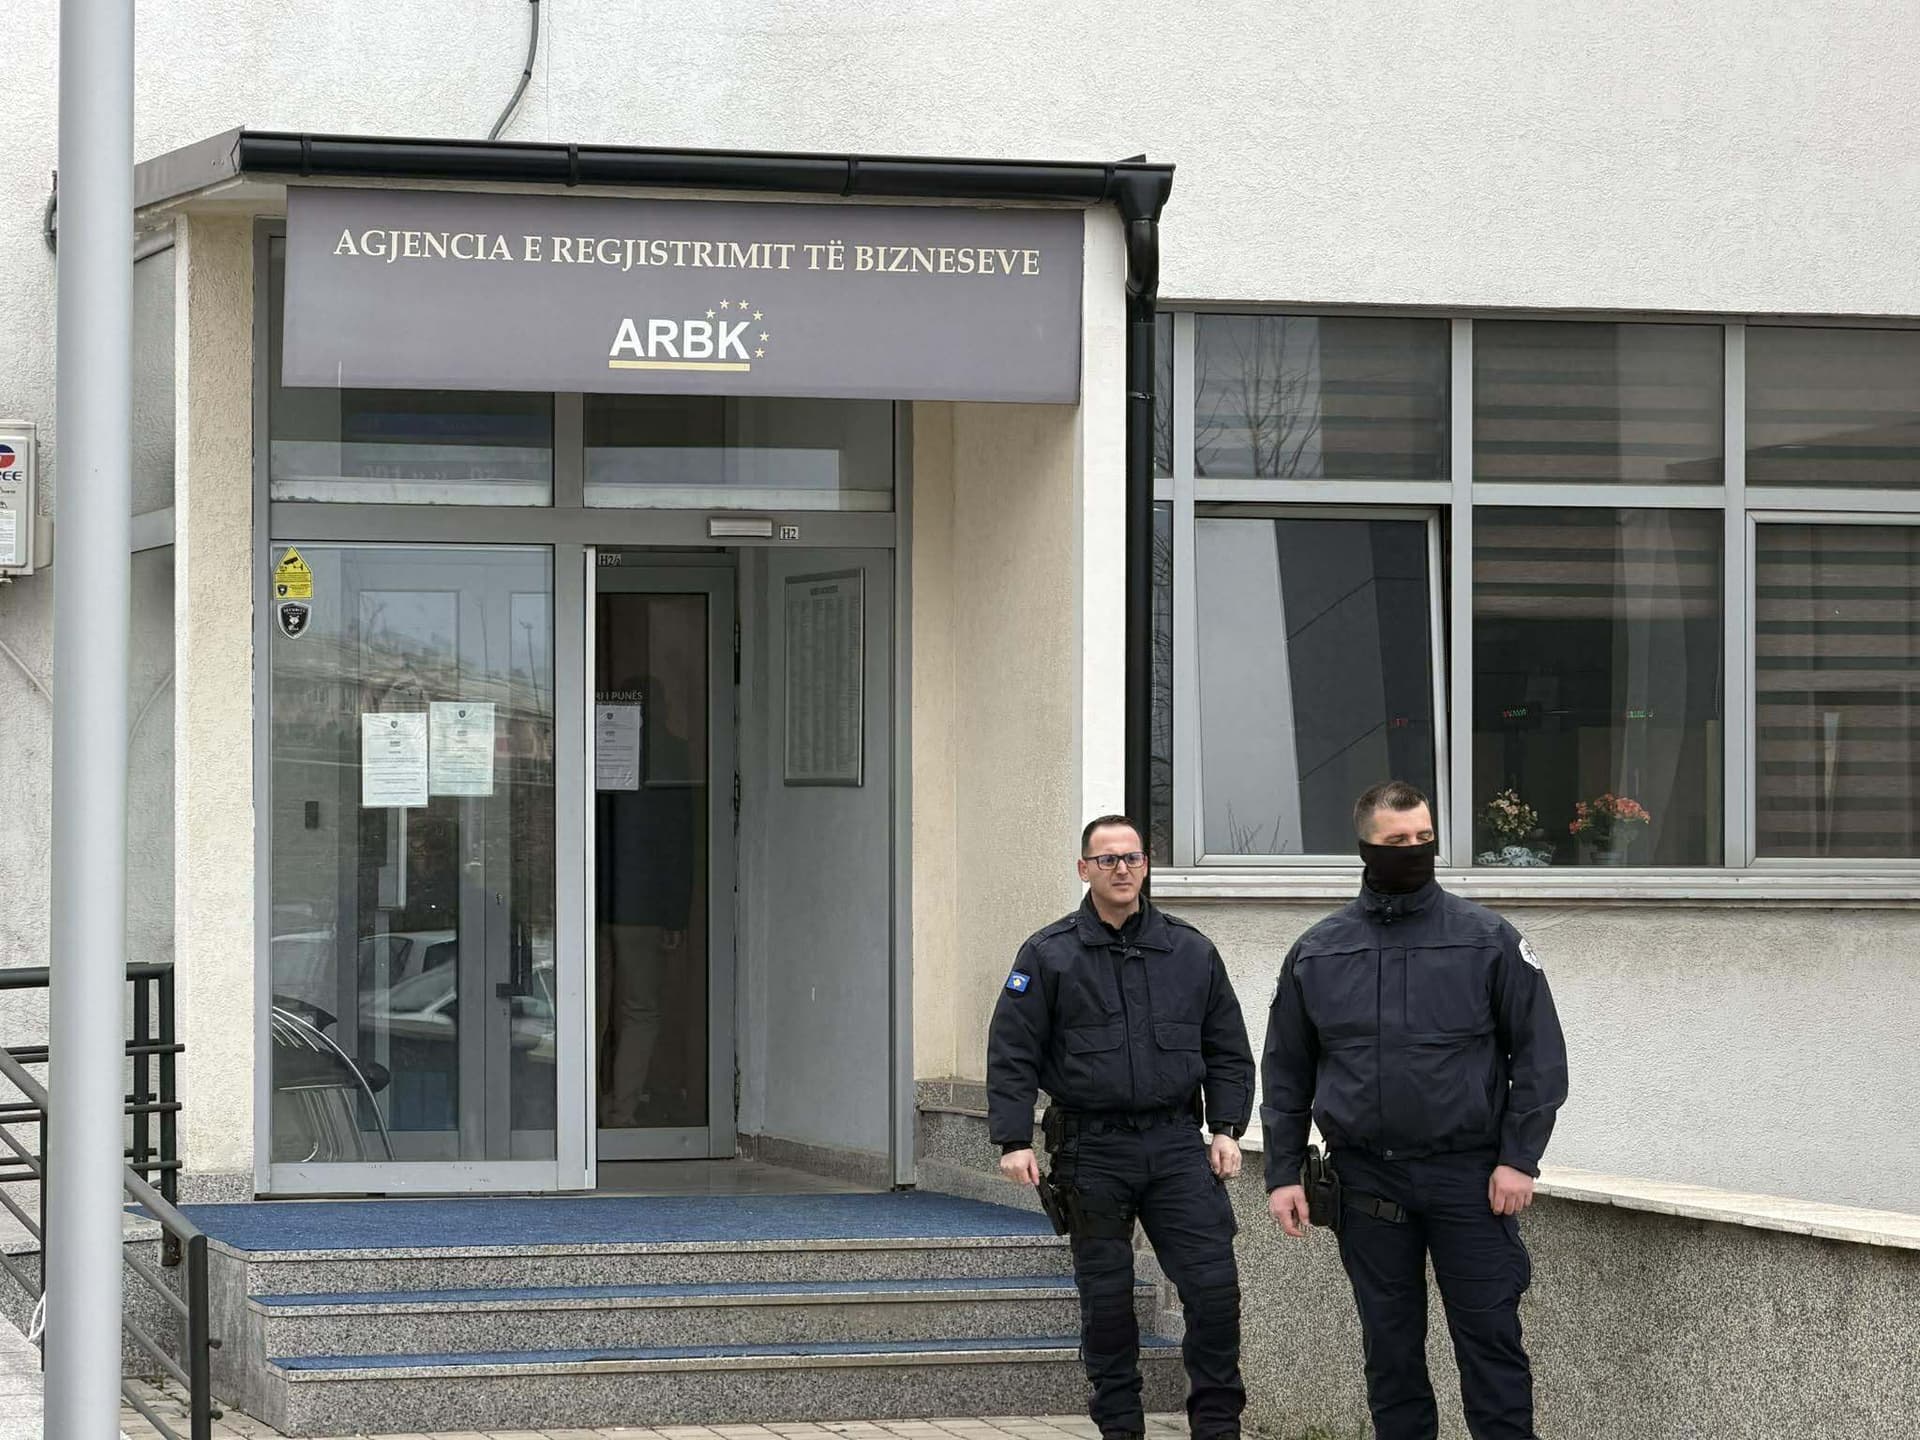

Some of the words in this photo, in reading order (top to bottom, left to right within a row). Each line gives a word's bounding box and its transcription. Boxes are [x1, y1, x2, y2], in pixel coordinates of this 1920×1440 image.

[333, 228, 514, 264] AGJENCIA
[522, 235, 543, 262] E
[551, 236, 796, 272] REGJISTRIMIT
[803, 239, 846, 271] TË
[853, 245, 1041, 276] BIZNESEVE
[608, 318, 751, 360] ARBK
[0, 470, 23, 482] EE
